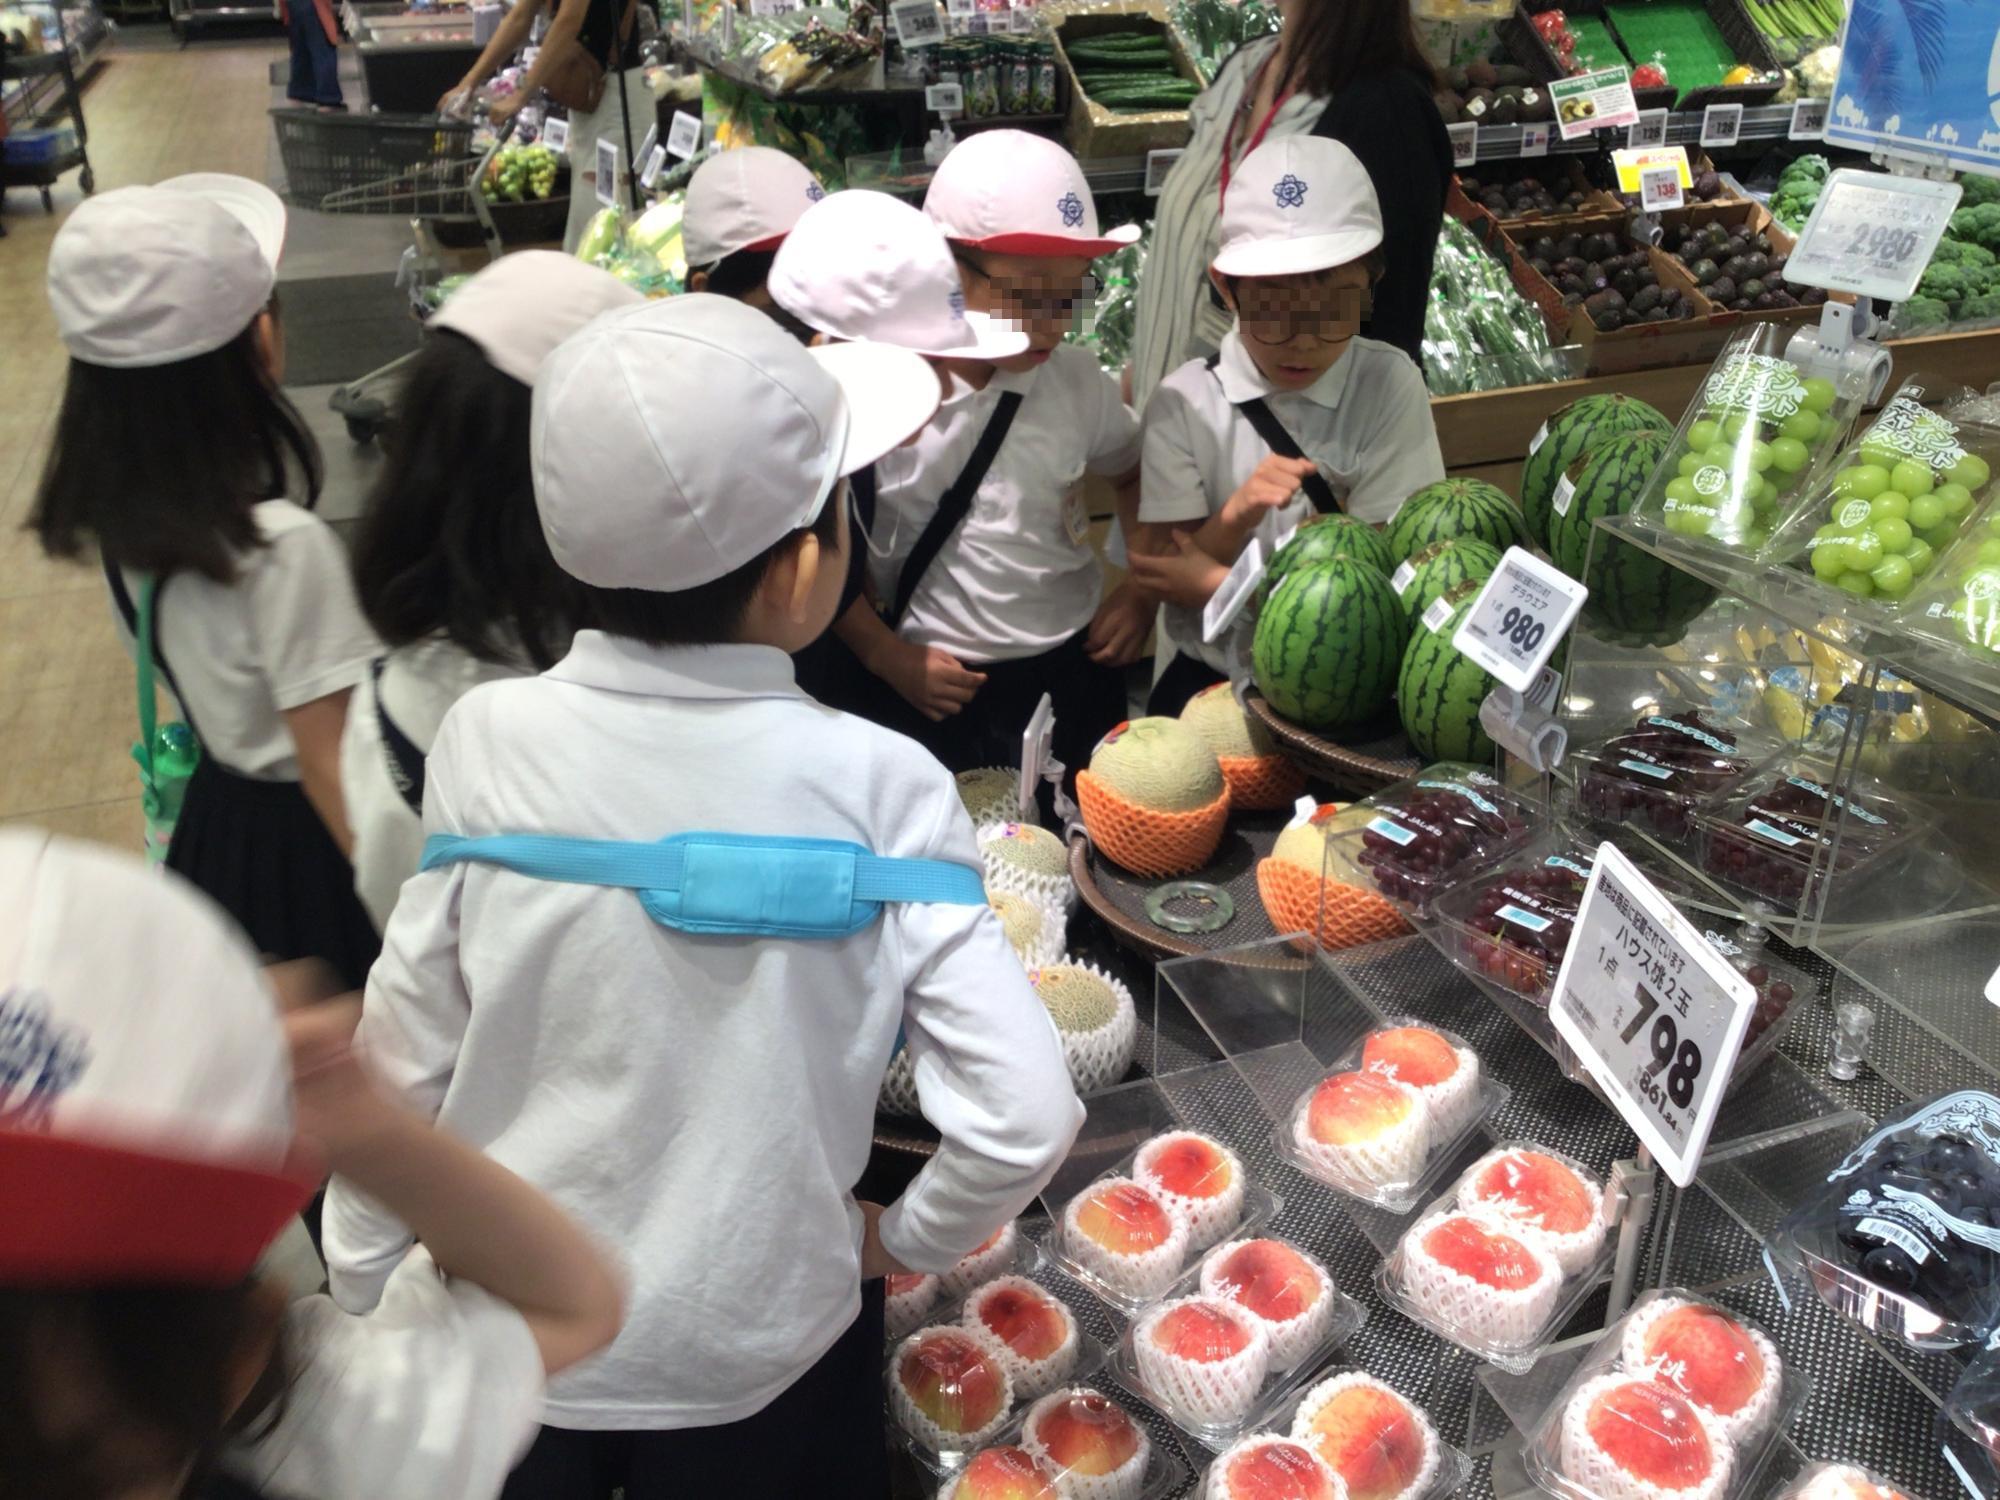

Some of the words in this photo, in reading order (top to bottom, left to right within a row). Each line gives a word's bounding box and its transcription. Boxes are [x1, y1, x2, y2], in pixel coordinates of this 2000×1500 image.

[1656, 183, 1676, 197] 138
[1498, 606, 1545, 652] 980
[1620, 981, 1702, 1109] 798
